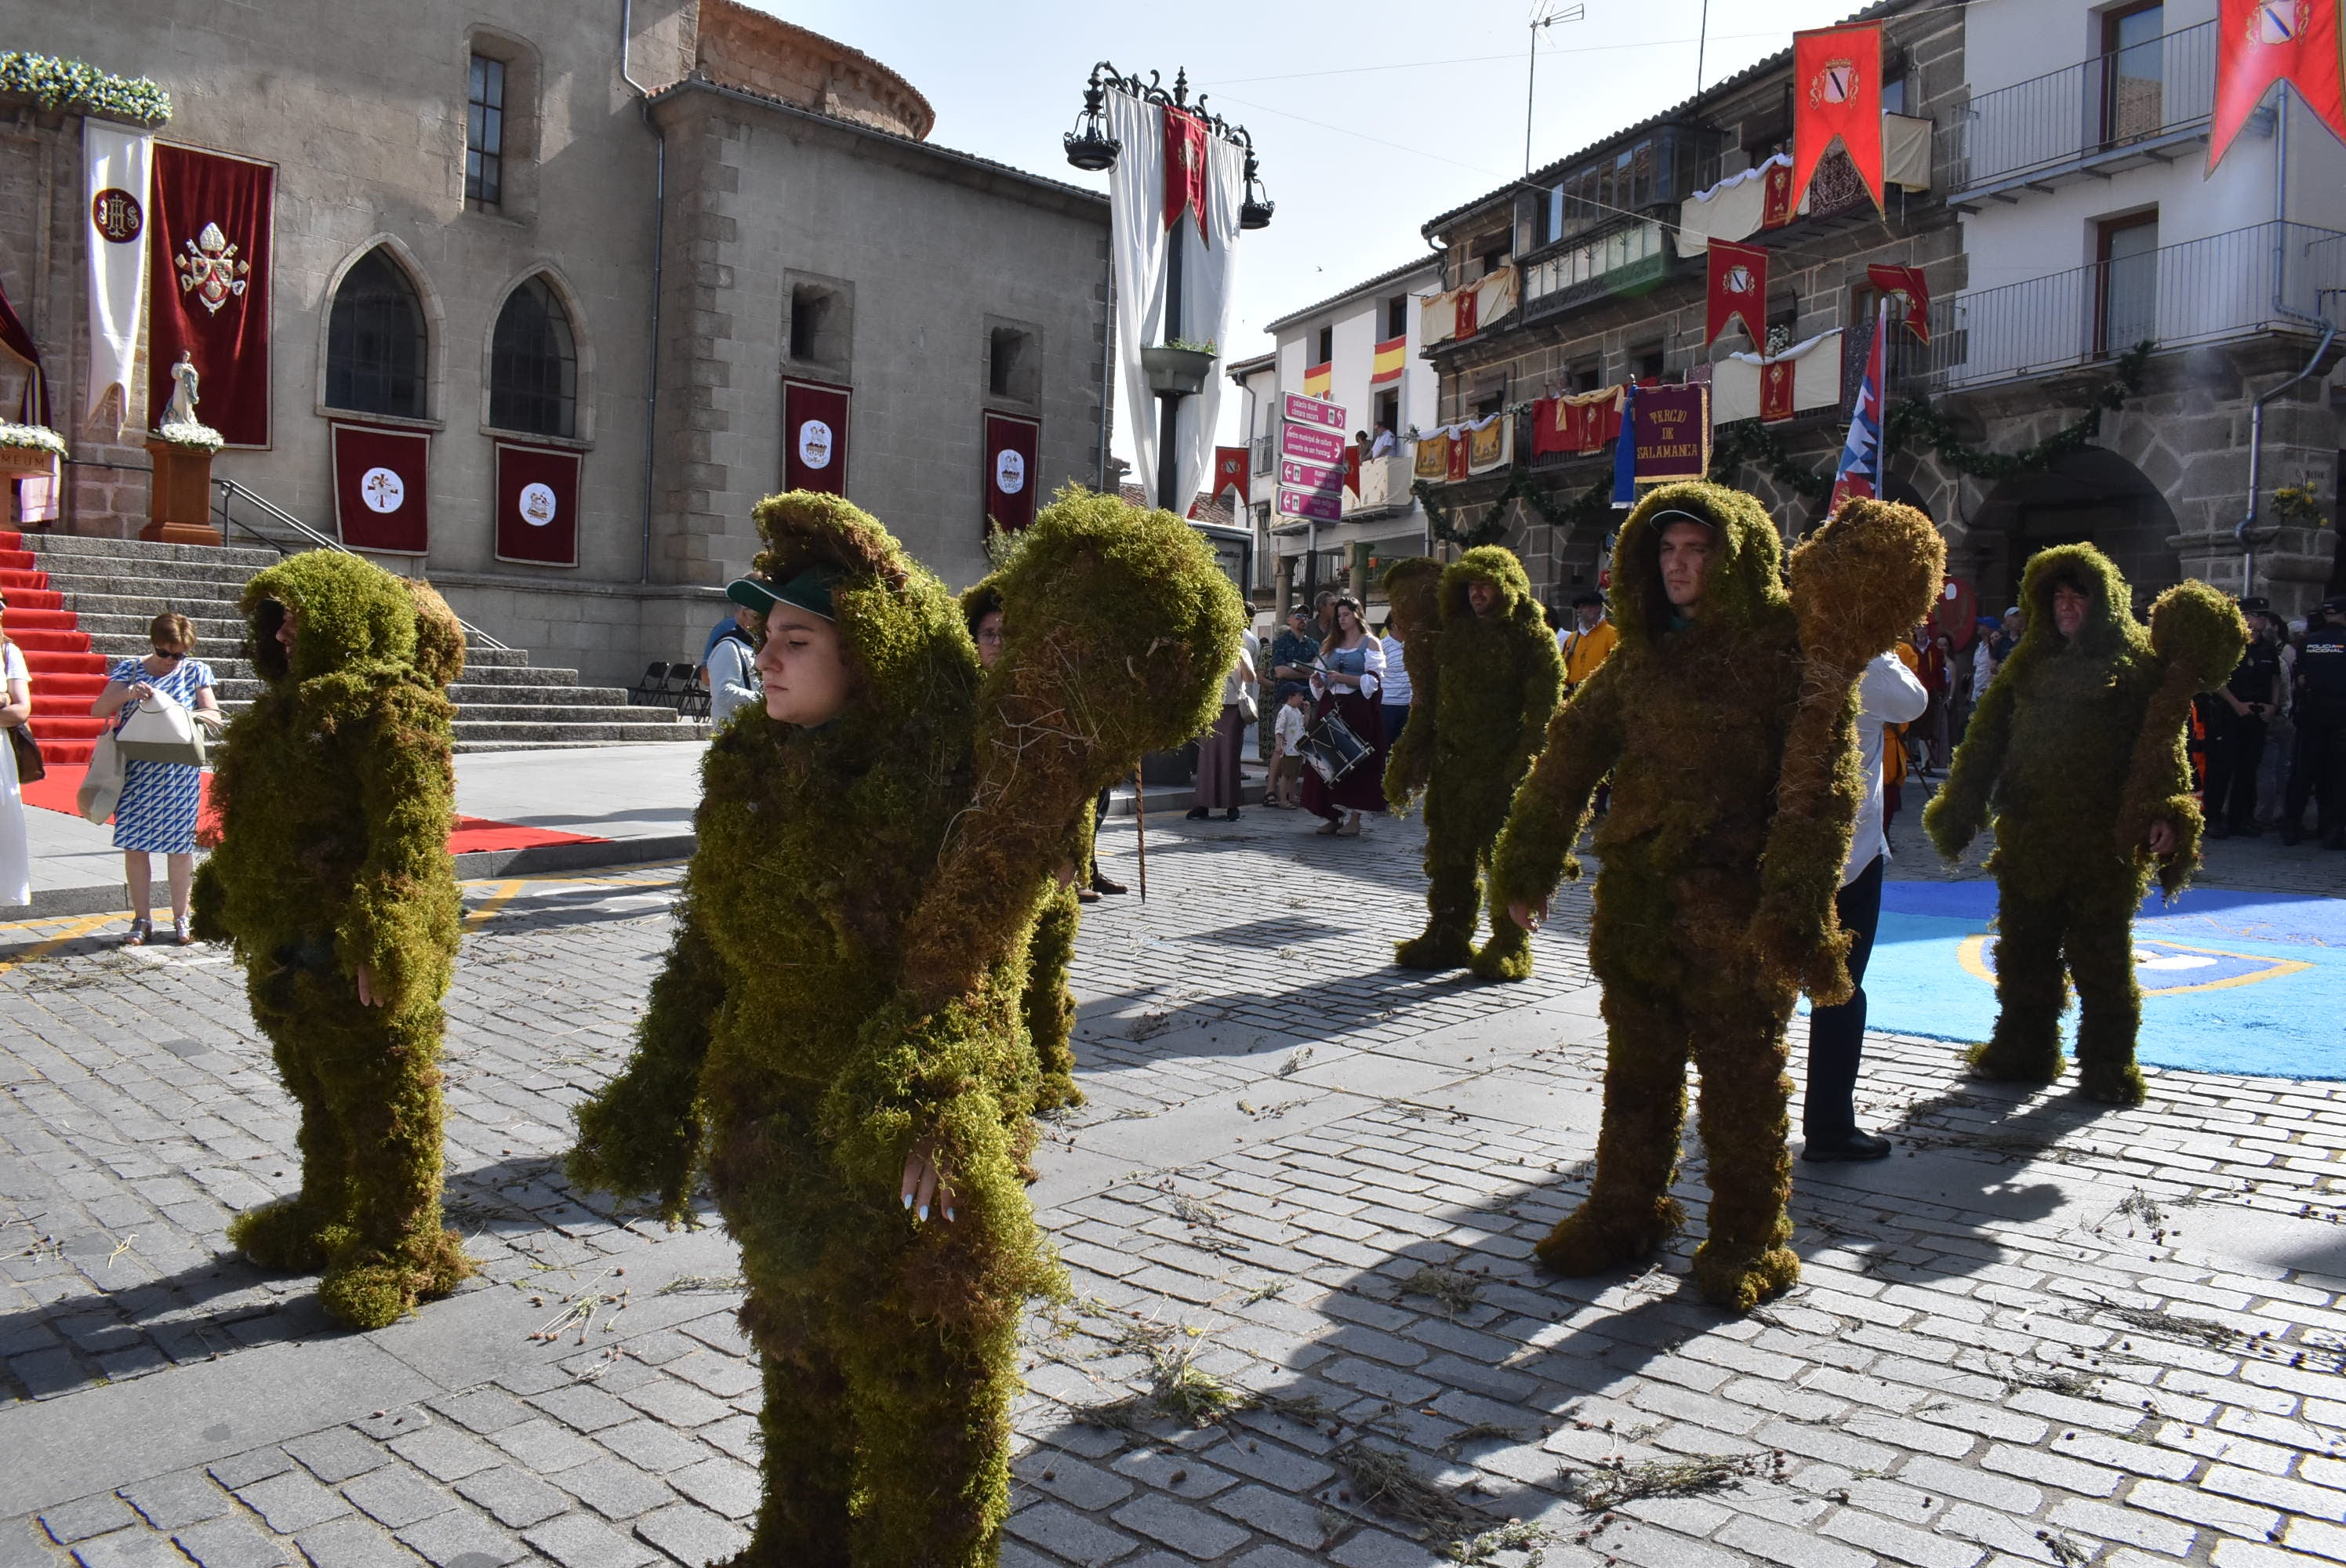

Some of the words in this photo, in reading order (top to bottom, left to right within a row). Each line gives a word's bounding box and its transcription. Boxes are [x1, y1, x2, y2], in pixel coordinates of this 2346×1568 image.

[1650, 410, 1687, 424] TERCIO
[1662, 427, 1673, 440] DE
[1636, 444, 1698, 459] SALAMANCA
[2, 454, 45, 467] MEUM
